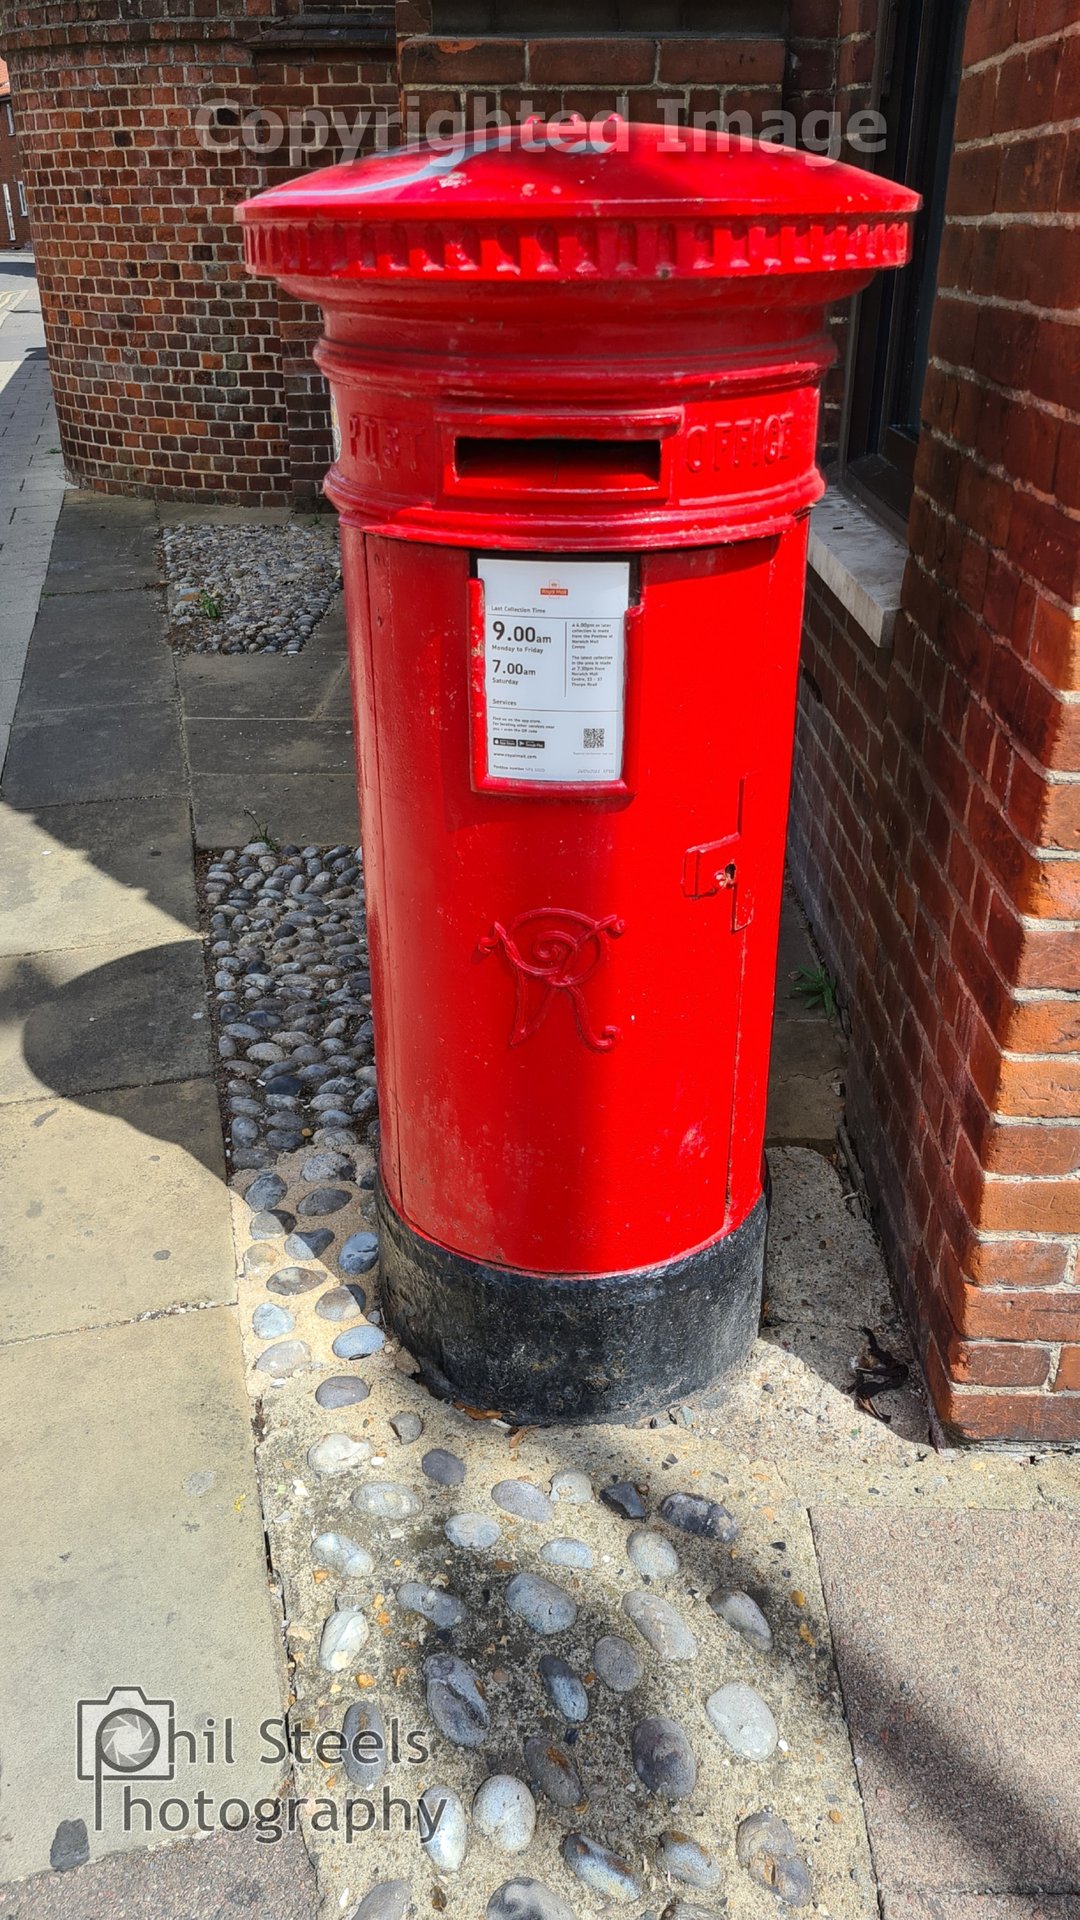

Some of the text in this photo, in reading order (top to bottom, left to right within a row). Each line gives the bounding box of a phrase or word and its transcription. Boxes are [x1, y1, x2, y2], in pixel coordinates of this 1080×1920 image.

[348, 412, 794, 473] POST OFFICE
[492, 620, 552, 643] 9.00am
[492, 644, 515, 653] Monday
[524, 646, 544, 655] Friday
[492, 659, 536, 675] 7.00am
[492, 677, 519, 686] Saturday
[492, 698, 517, 706] Services
